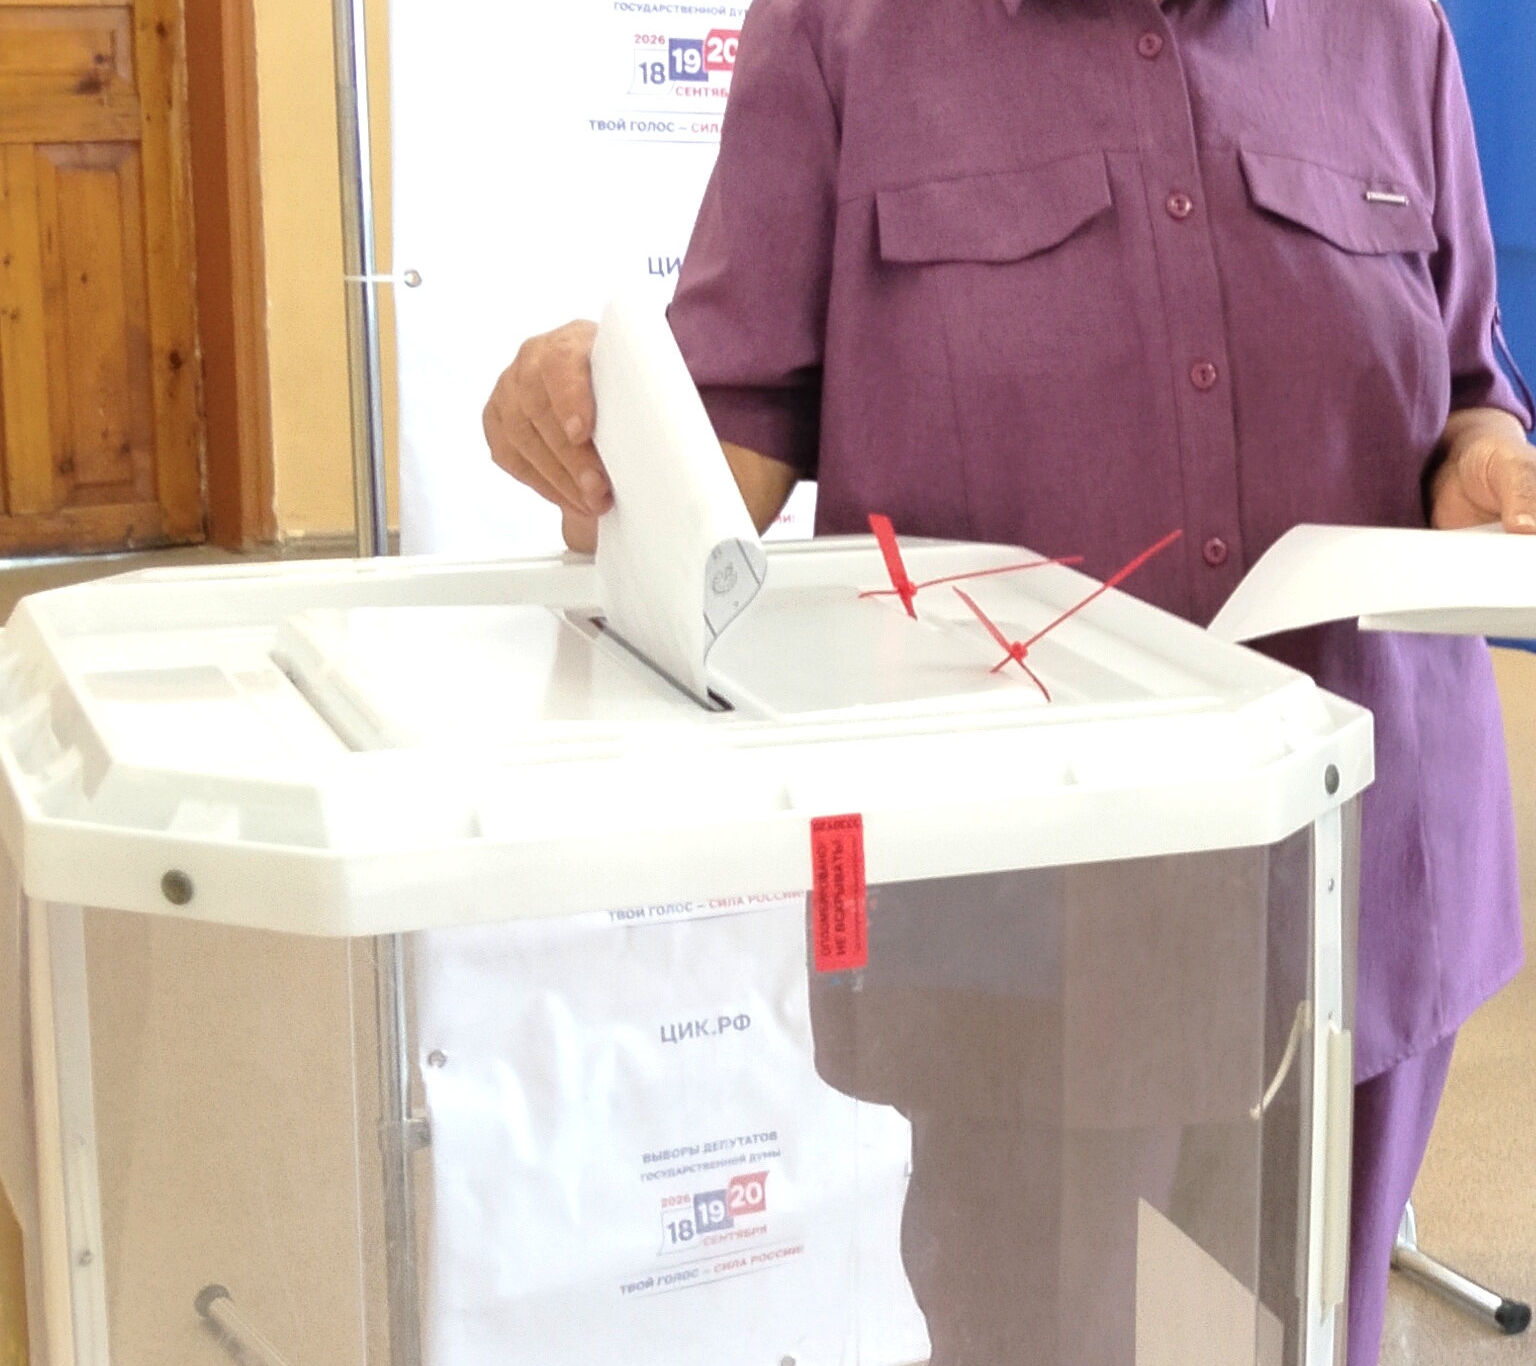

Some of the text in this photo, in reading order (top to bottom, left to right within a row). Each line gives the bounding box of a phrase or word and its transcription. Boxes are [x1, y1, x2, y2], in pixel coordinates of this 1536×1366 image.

[634, 33, 666, 46] 2026
[639, 61, 666, 85] 18
[671, 47, 702, 75] 19
[675, 85, 730, 99] СЕНТЯБ
[588, 117, 627, 132] ТВОЙ
[630, 120, 676, 133] ГОЛОС
[691, 121, 722, 134] СИЛ
[649, 901, 693, 918] ГОЛОС
[659, 1013, 752, 1044] ЦИК.РФ
[642, 1131, 778, 1164] ВЫБОРЫ ДЕПУТАТОВ
[661, 1194, 691, 1208] 2026
[667, 1181, 763, 1244] 18 19 20
[703, 1224, 767, 1246] СЕНТЯБРЯ
[620, 1276, 655, 1295] ТВОЙ
[657, 1268, 700, 1287] ГОЛОС
[714, 1258, 747, 1274] СИЛА
